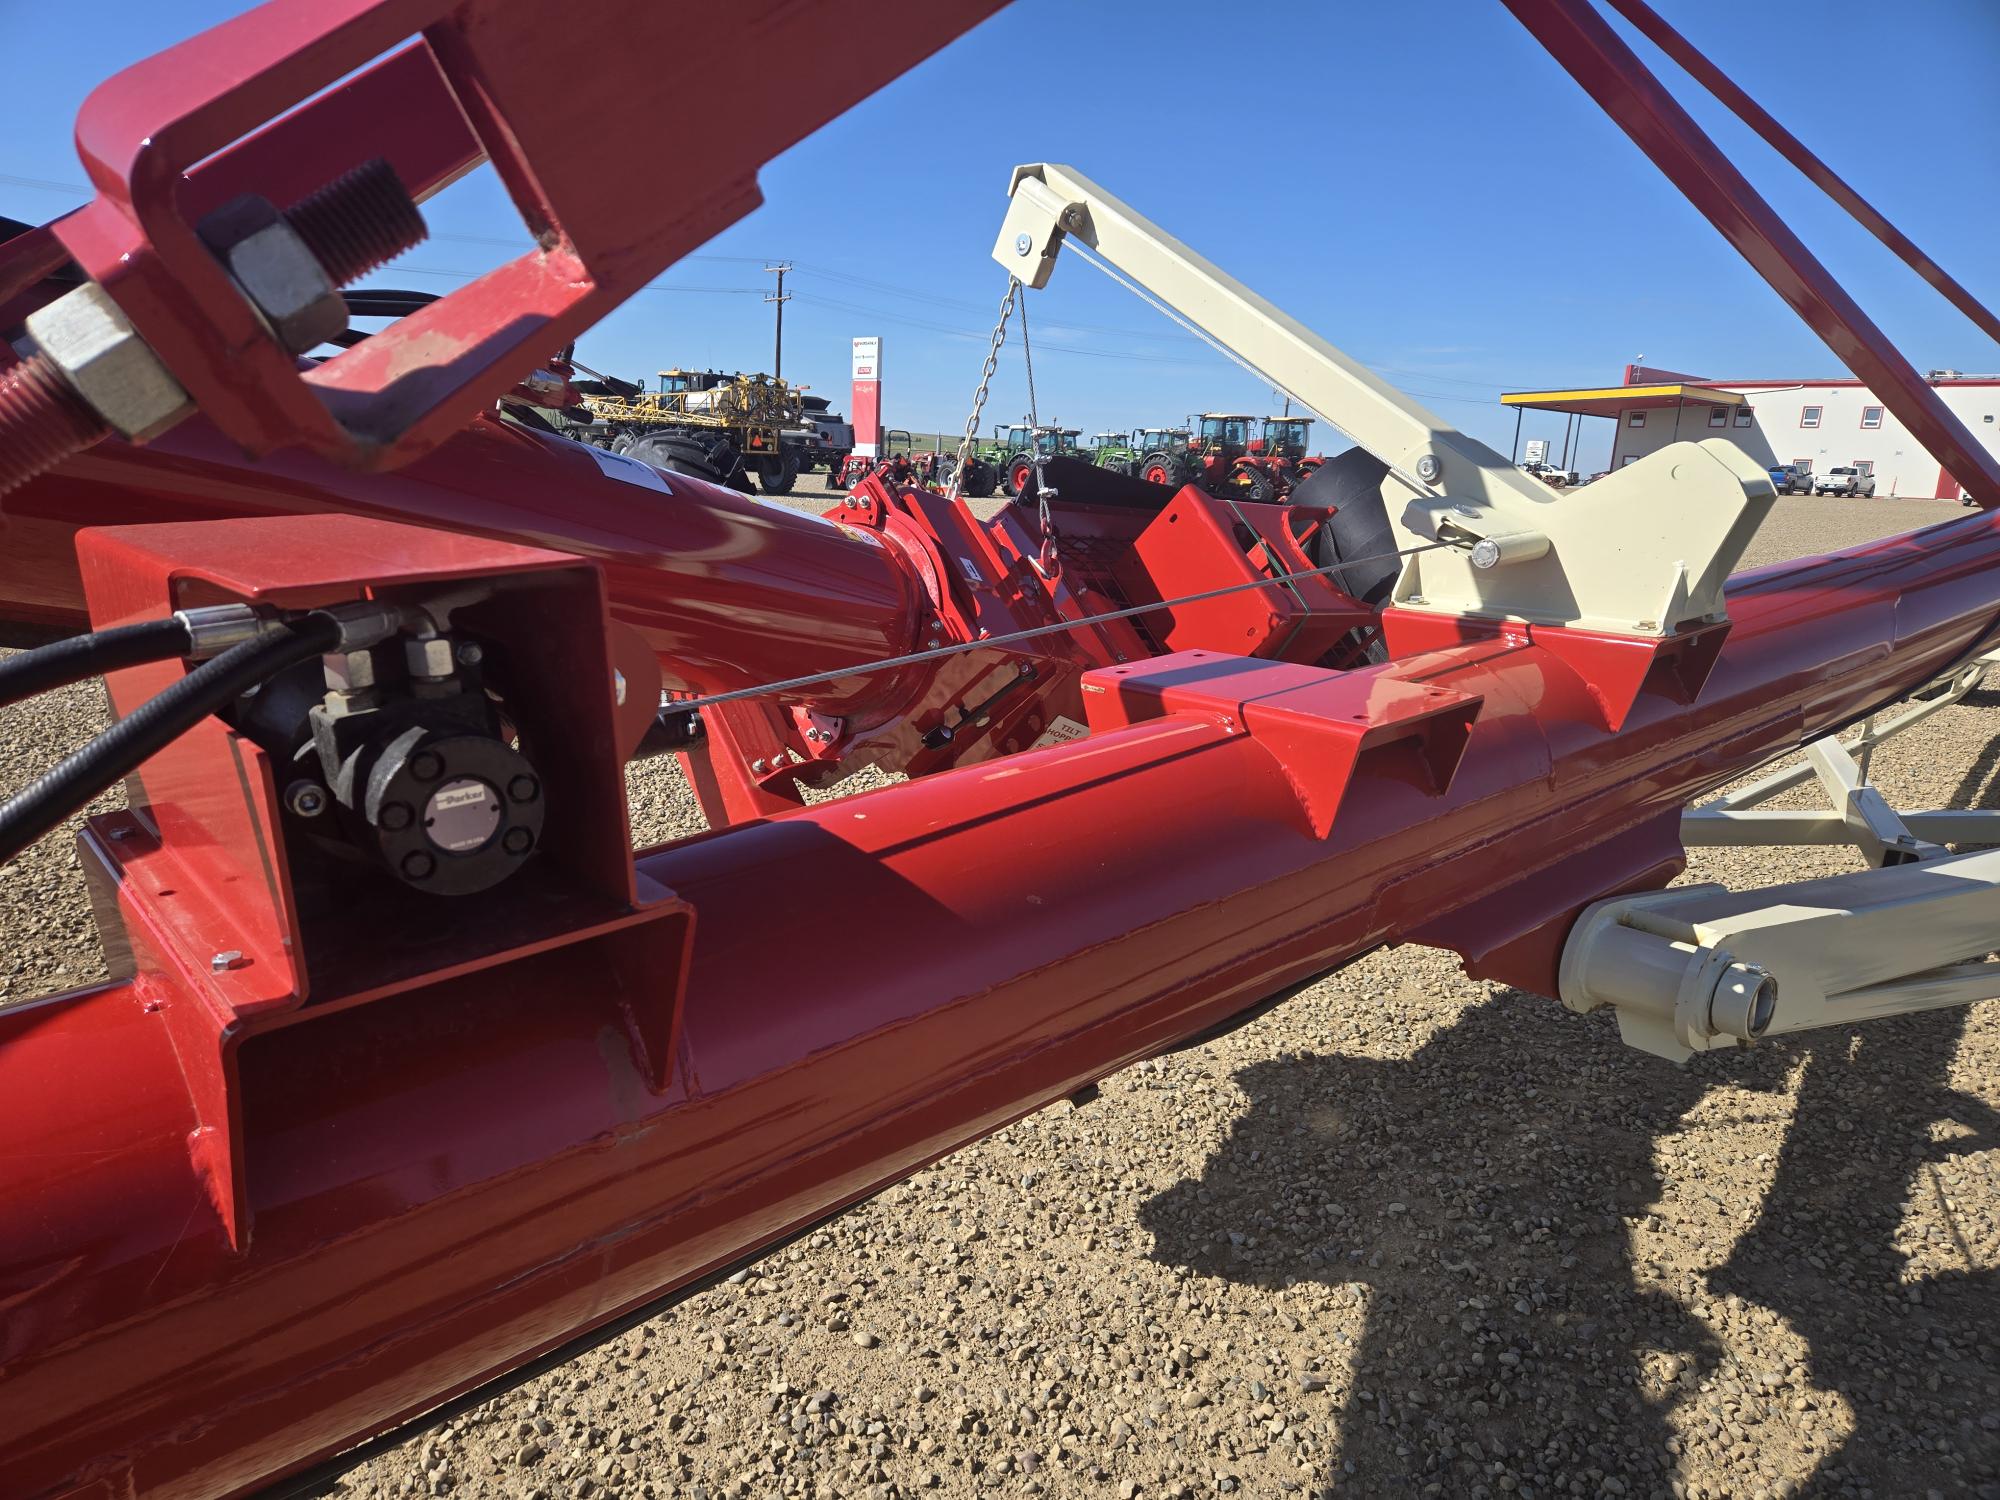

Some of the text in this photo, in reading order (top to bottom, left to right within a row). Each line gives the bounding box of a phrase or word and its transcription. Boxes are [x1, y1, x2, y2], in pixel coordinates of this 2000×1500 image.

[1047, 728, 1073, 741] HOPP
[1061, 724, 1081, 736] TILT
[445, 791, 482, 805] Parker
